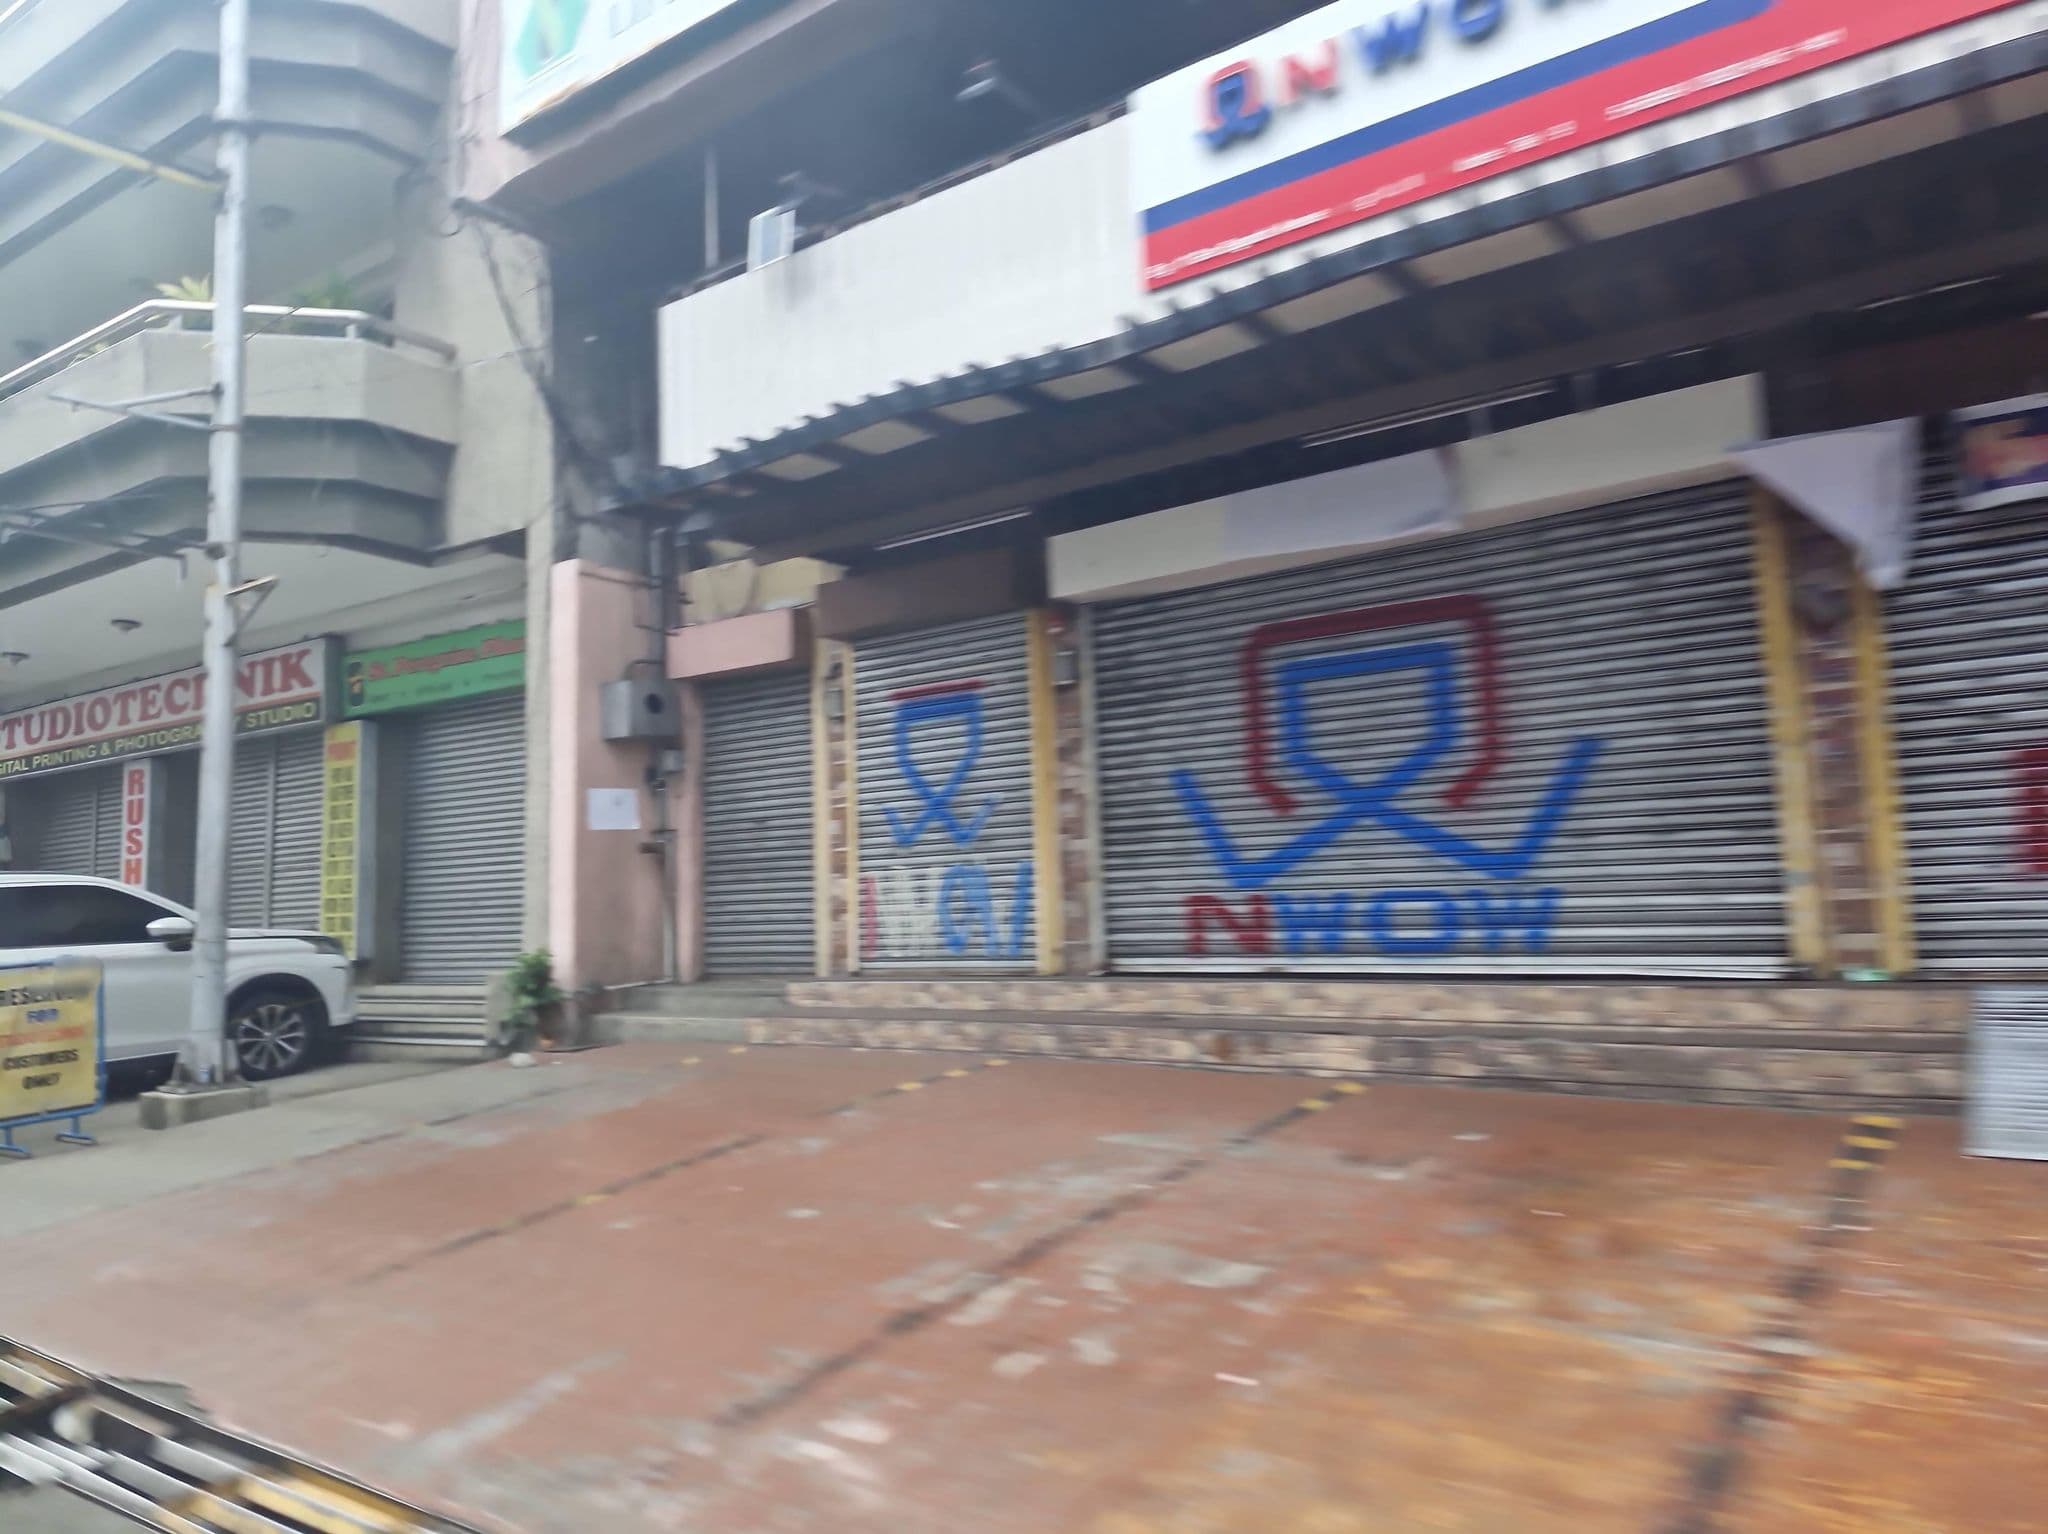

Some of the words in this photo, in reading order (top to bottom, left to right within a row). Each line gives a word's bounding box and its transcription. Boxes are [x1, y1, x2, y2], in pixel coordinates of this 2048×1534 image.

[0, 648, 314, 750] TUDIOTECNIK
[33, 745, 96, 768] PRINTING
[115, 718, 240, 753] PHOTOGRA
[247, 702, 316, 728] STUDIO
[124, 767, 145, 885] RUSH
